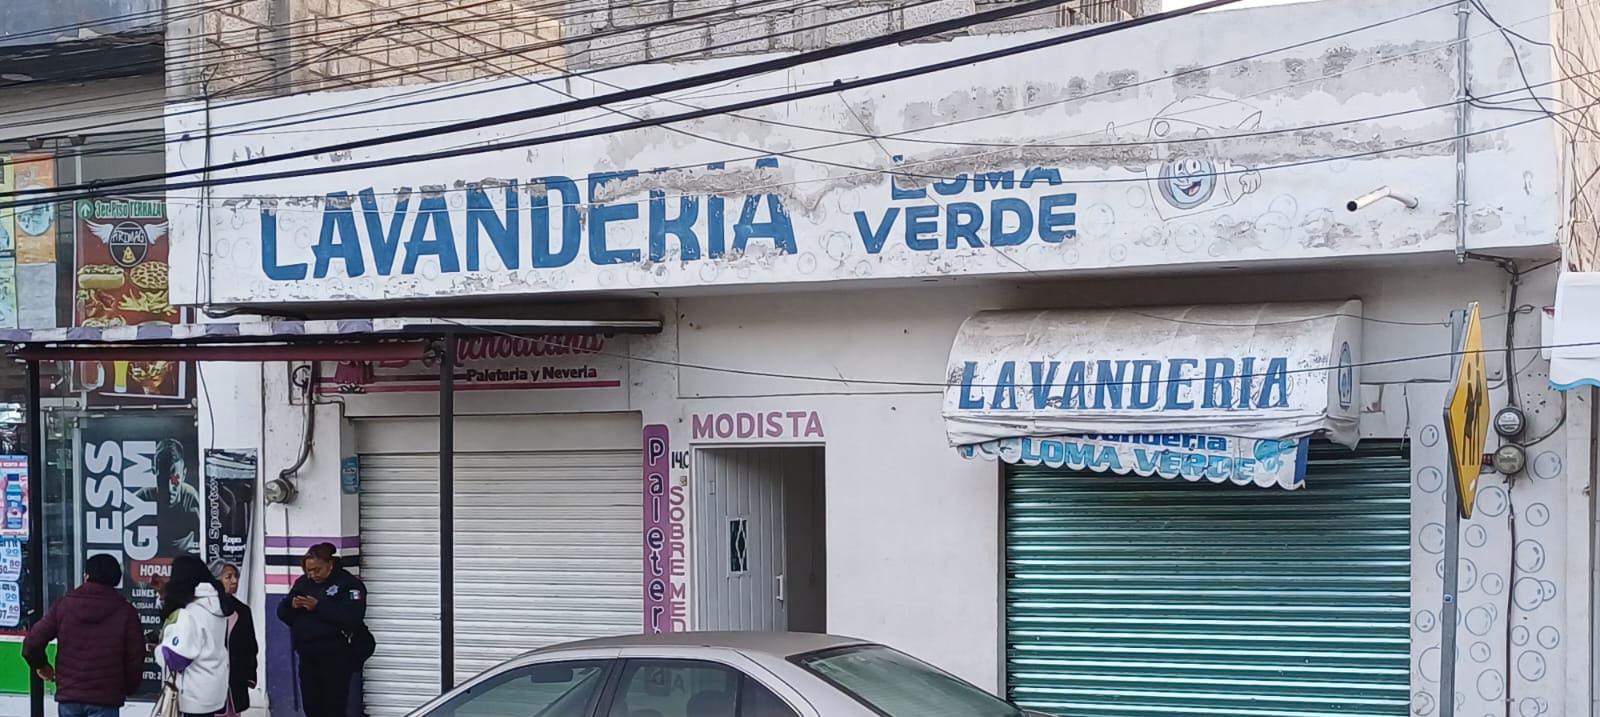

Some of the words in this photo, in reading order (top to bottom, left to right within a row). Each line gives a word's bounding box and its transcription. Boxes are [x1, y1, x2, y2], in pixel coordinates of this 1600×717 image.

[260, 157, 797, 281] LAVANDERIA
[853, 193, 1077, 254] VERDE
[532, 370, 541, 382] y
[957, 356, 1290, 411] LAVANDERIA
[692, 410, 825, 439] MODISTA
[1019, 437, 1123, 472] LOMA
[1133, 449, 1256, 480] VERDE
[122, 440, 159, 561] GYM
[669, 486, 686, 577] SOBRE
[131, 588, 155, 598] LUNES
[670, 582, 687, 632] MED
